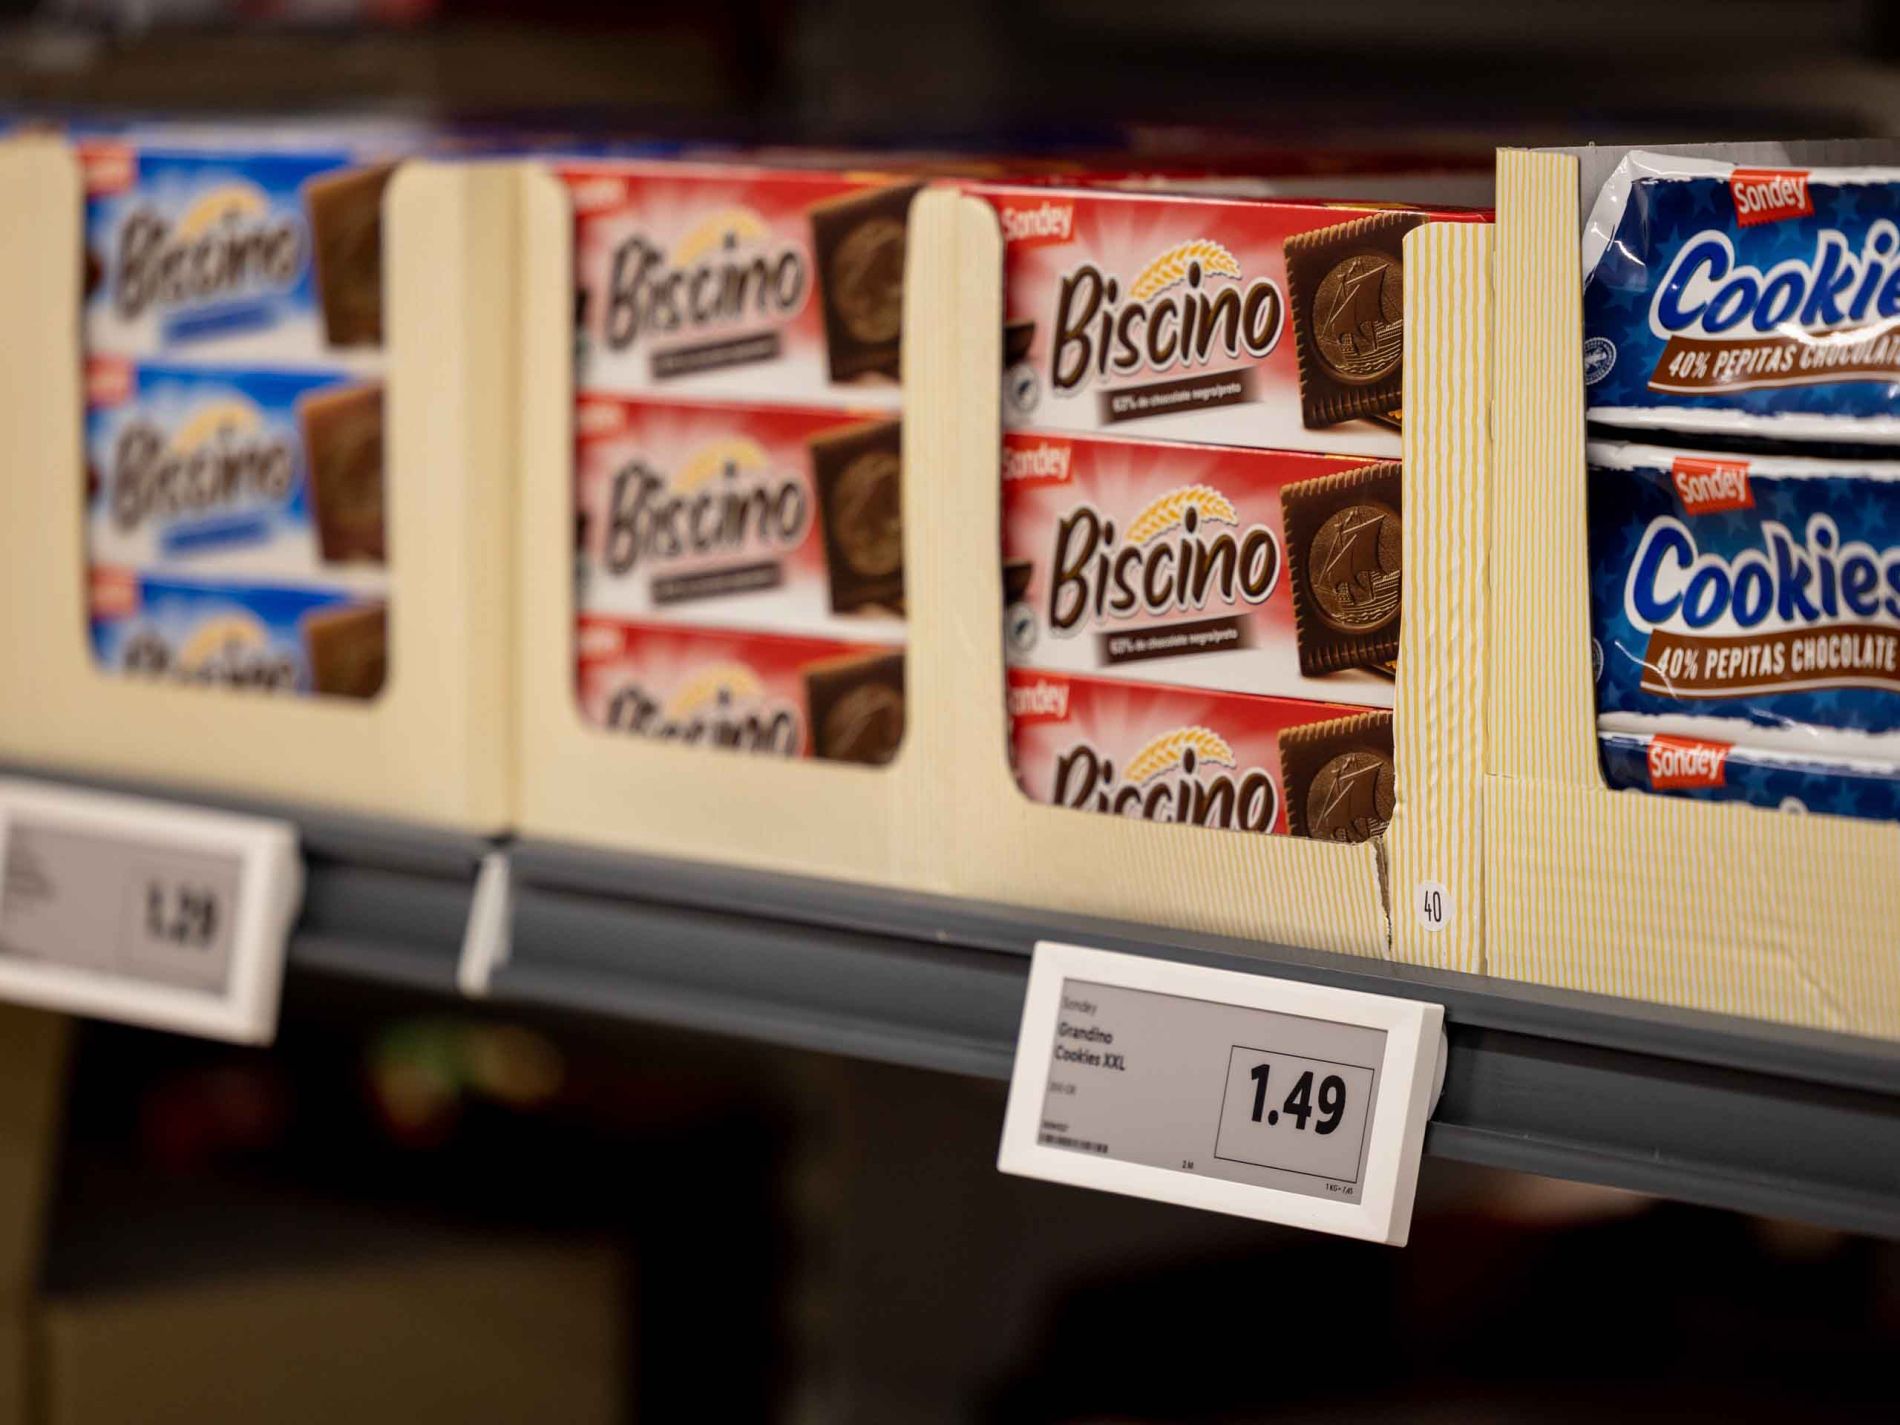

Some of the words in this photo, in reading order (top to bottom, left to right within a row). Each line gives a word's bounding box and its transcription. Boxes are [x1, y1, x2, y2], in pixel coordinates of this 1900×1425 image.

[1733, 176, 1806, 214] Sondey
[1002, 200, 1073, 240] Sondey
[606, 232, 802, 350] Biscino
[1051, 260, 1281, 389] Biscino
[1668, 350, 1708, 378] 40%
[1712, 346, 1797, 379] PEPITAS
[1799, 333, 1900, 370] CHOCOLAT
[1675, 463, 1748, 503] Sondey
[604, 460, 802, 574] Biscino
[1048, 505, 1276, 629] Biscino
[1657, 647, 1699, 680] 40%
[1704, 641, 1786, 680] PEPITAS
[1791, 633, 1897, 676] CHOCOLATE
[1008, 678, 1069, 719] ondey
[1651, 740, 1726, 778] Sondey
[1424, 890, 1442, 922] 40
[1058, 1021, 1113, 1045] Grandino
[1053, 1044, 1101, 1067] Cookies
[1103, 1052, 1125, 1071] XXL
[1250, 1062, 1347, 1136] 1.49
